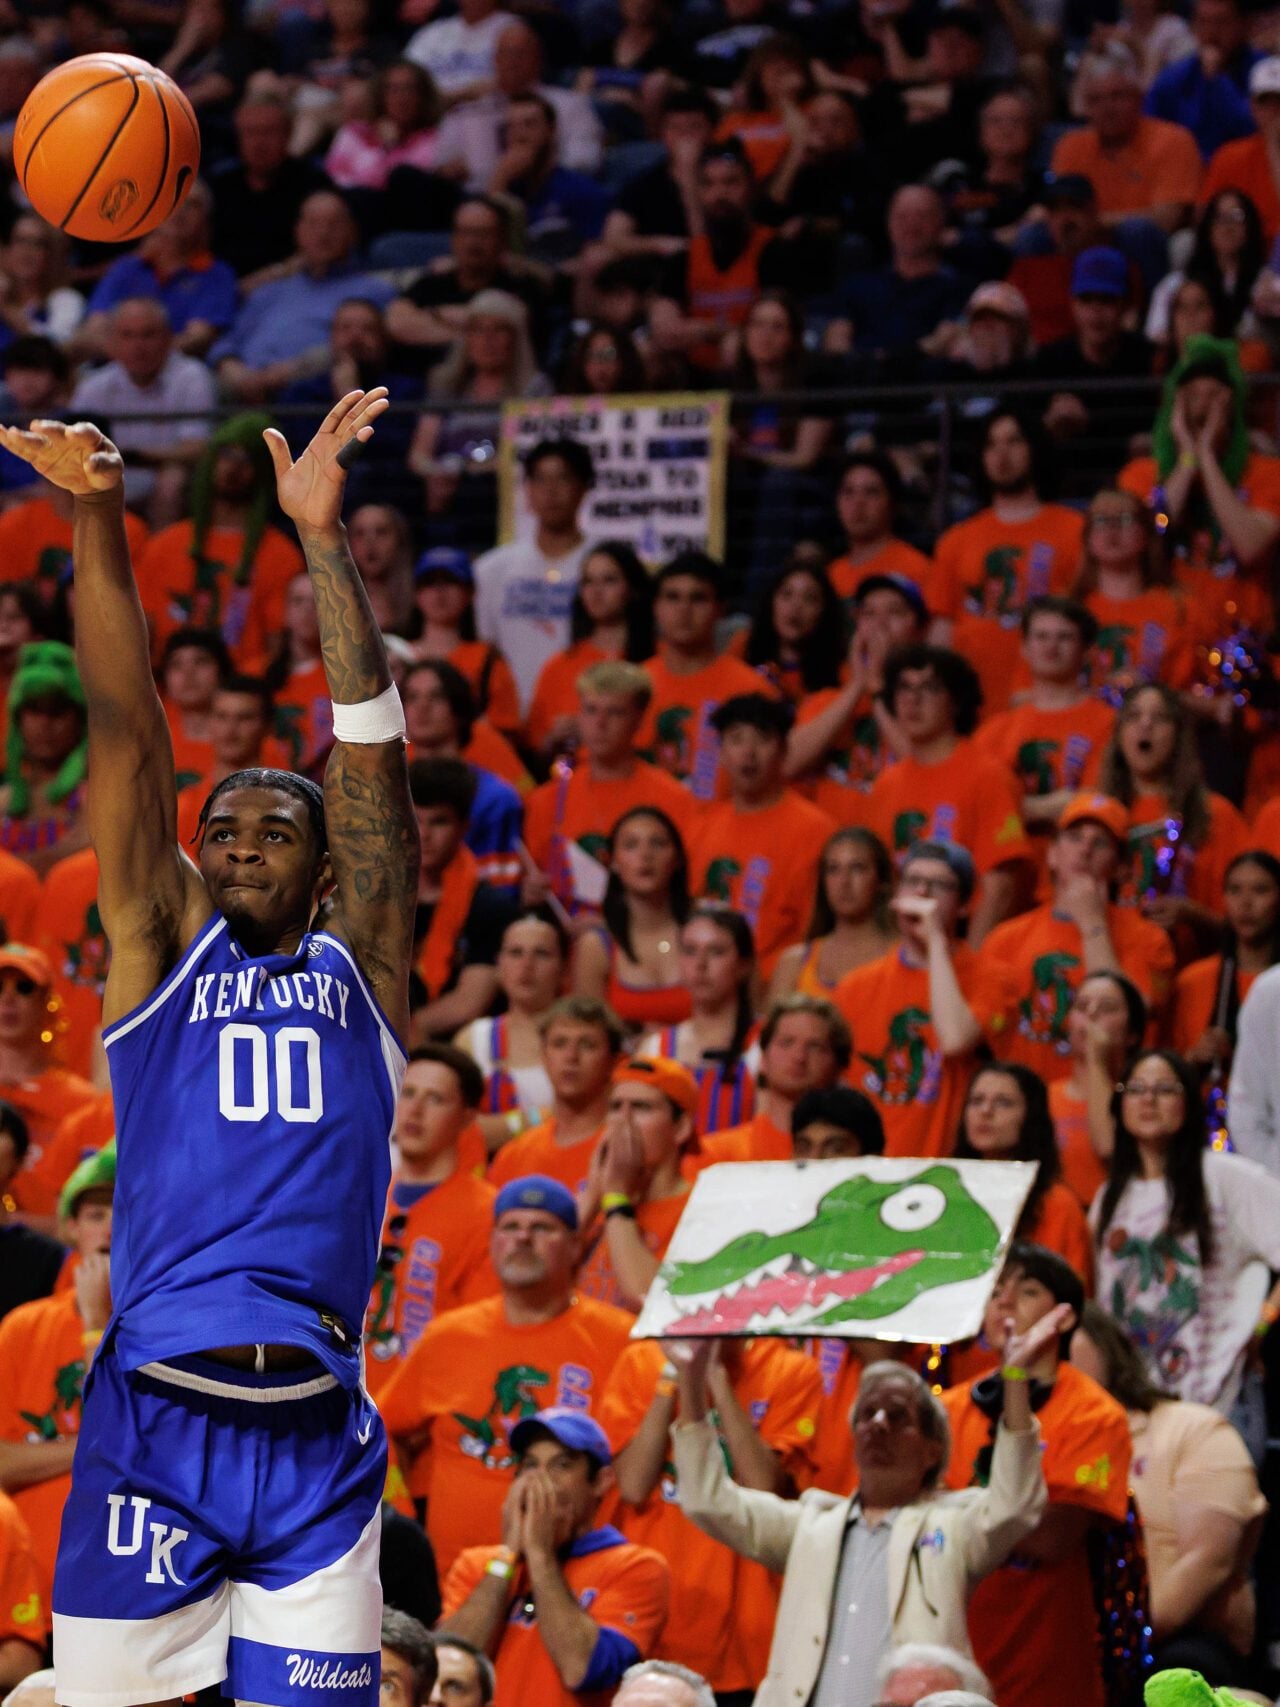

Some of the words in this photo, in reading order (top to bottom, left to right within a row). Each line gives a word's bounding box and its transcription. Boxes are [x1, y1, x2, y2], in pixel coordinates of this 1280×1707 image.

[188, 965, 351, 1030] KENTUCKY
[218, 1022, 324, 1123] 00
[106, 1493, 189, 1587] UK
[285, 1653, 372, 1689] Wildcats
